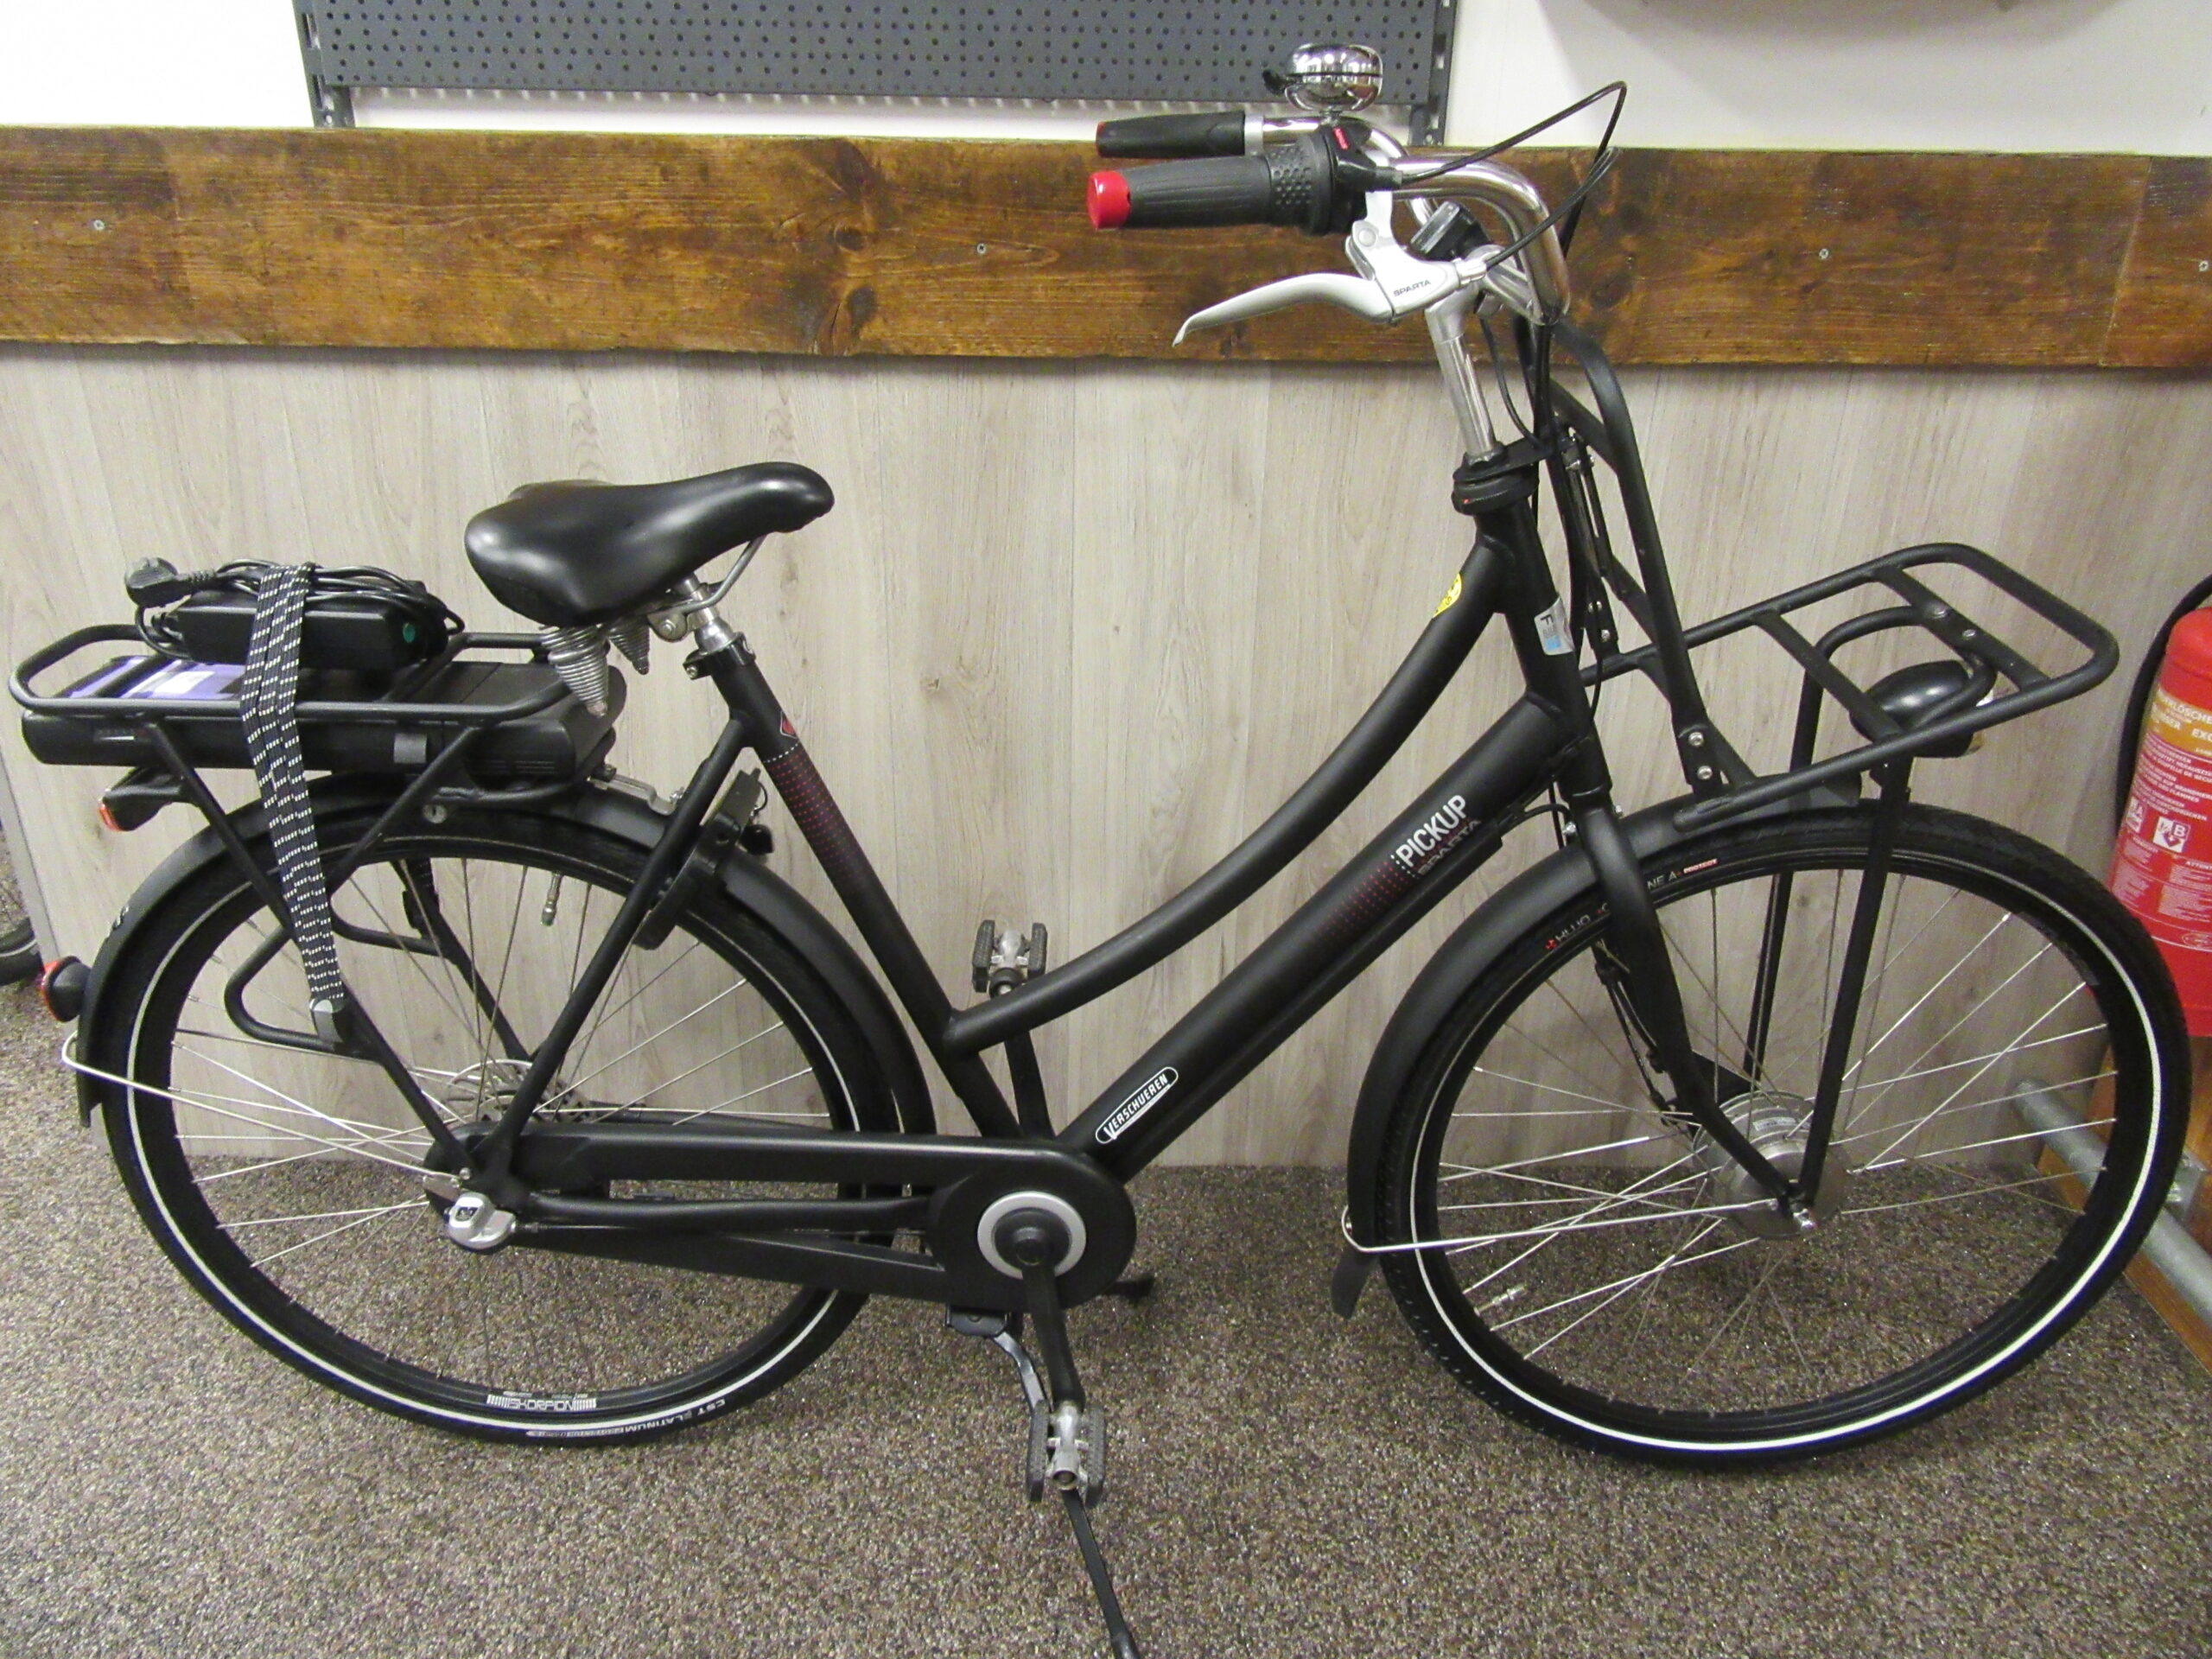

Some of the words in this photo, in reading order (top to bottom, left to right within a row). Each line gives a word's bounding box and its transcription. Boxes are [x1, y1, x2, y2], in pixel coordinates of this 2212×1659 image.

[1393, 279, 1431, 296] SPARTA
[1395, 794, 1466, 868] PICKUP
[1103, 1073, 1168, 1140] VERSCHUEREN
[508, 1397, 575, 1411] SKORPION
[696, 1397, 726, 1416] CST
